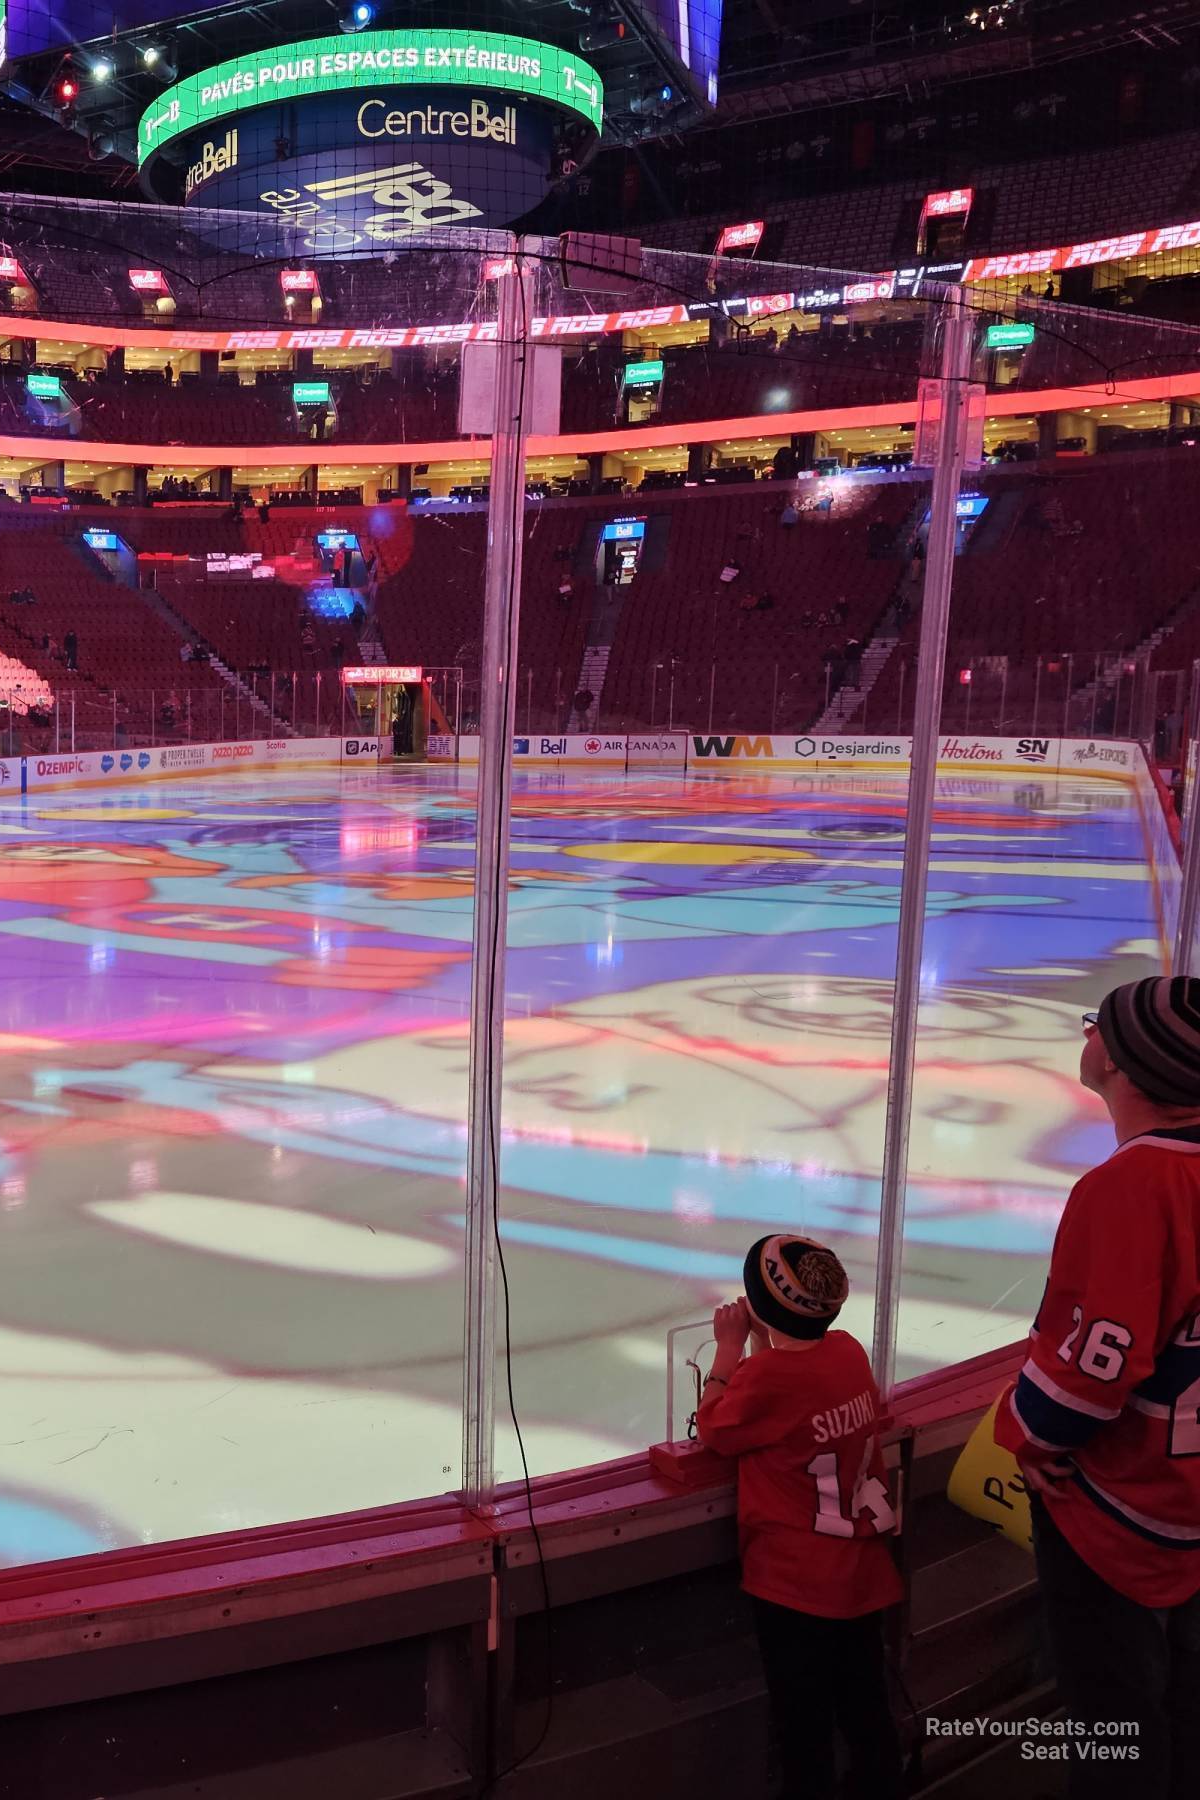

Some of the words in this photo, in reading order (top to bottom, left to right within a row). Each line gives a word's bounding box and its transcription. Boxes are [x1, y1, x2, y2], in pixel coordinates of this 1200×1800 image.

[201, 71, 254, 106] PAVÉS
[259, 58, 315, 87] POUR
[320, 47, 419, 75] ESPACES
[424, 45, 541, 78] EXTÉRIEURS
[540, 738, 567, 754] Bell
[604, 741, 623, 751] AIR
[625, 740, 677, 751] CANADA
[693, 736, 774, 757] WM
[821, 741, 901, 755] Desjardins
[941, 738, 1004, 761] Hortons
[1016, 739, 1049, 754] SN
[811, 1389, 875, 1444] SUZUKI
